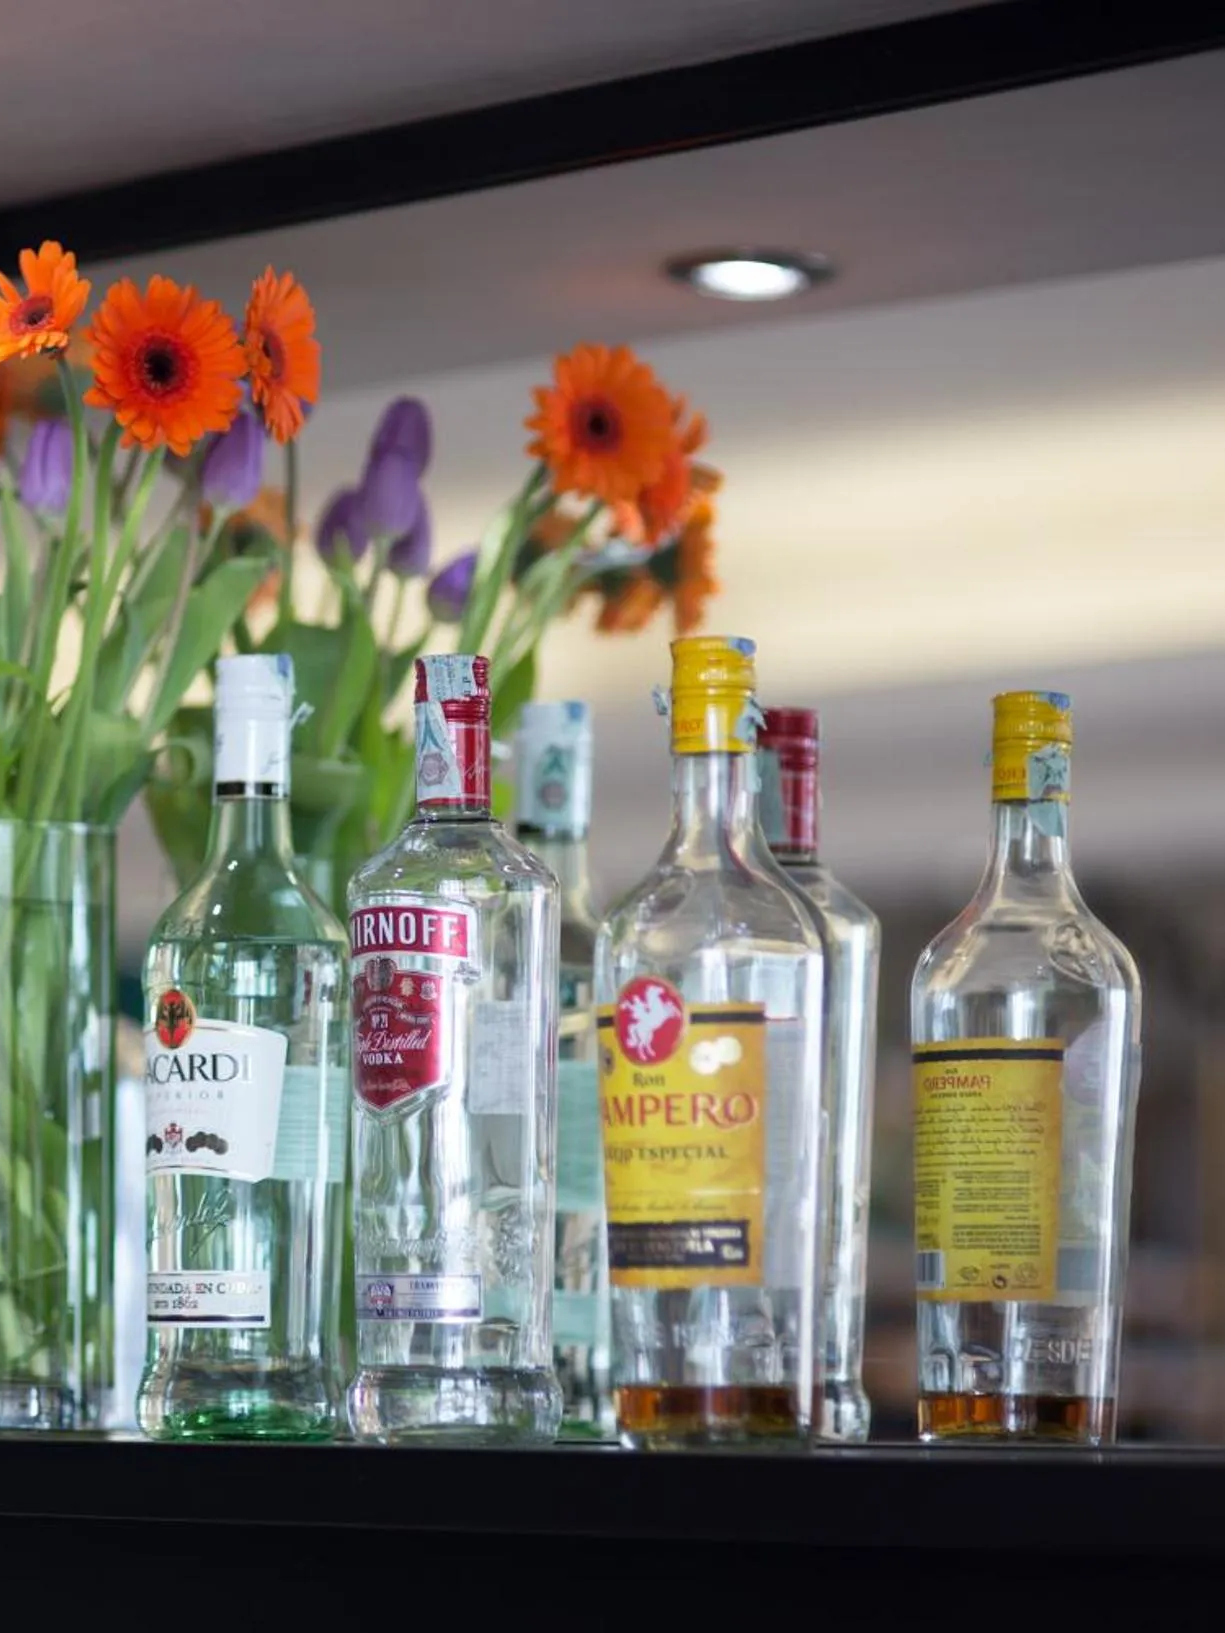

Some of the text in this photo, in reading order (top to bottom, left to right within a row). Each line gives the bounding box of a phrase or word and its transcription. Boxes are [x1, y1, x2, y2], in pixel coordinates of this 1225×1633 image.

[352, 912, 460, 949] IRNOFF
[362, 1051, 405, 1067] VODKA
[632, 1071, 665, 1087] Ron
[638, 1145, 729, 1161] ESPECIAL
